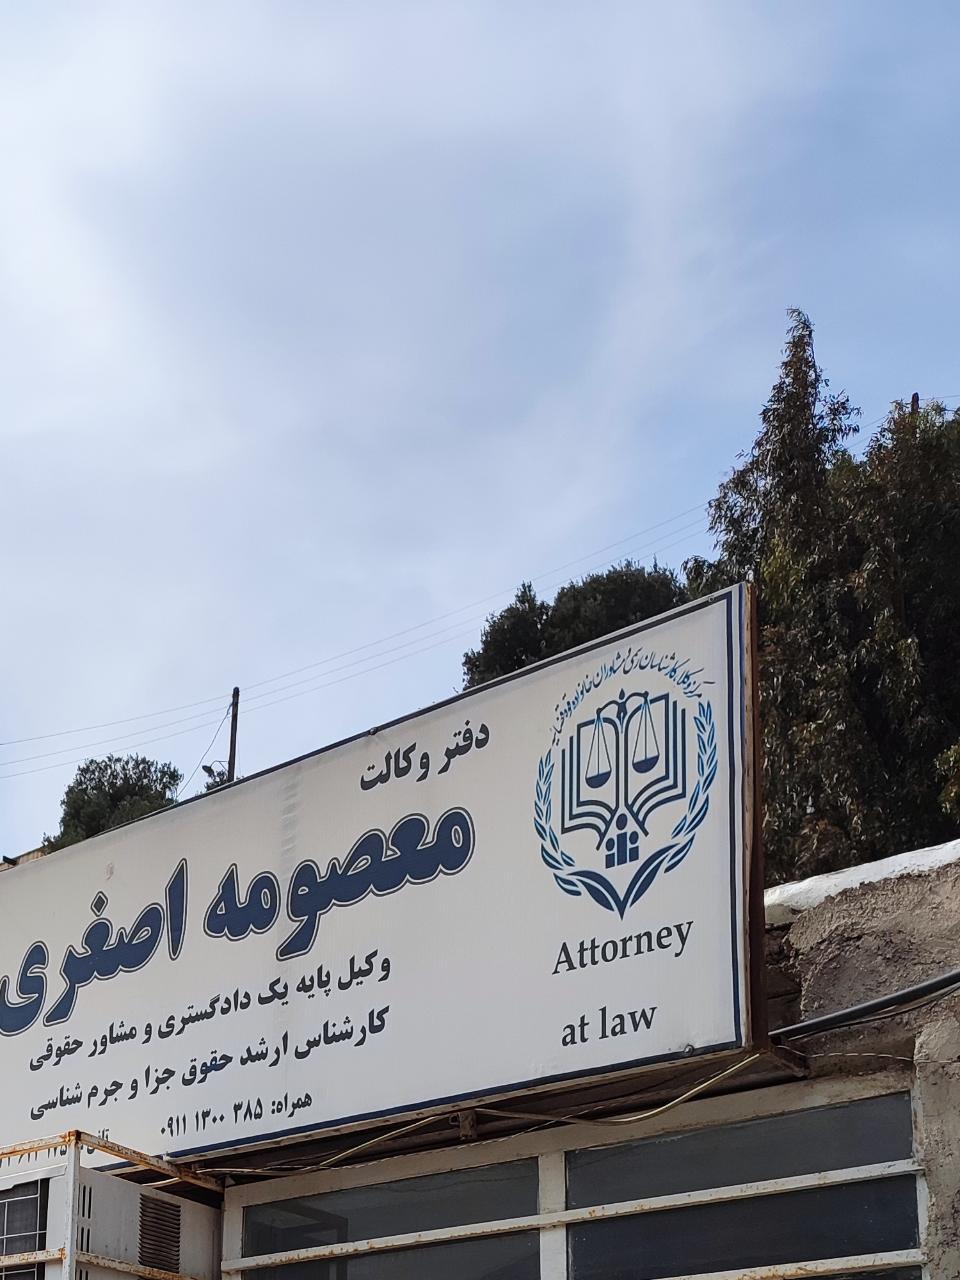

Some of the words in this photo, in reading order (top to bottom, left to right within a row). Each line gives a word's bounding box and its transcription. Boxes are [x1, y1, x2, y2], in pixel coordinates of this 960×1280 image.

[437, 719, 490, 775] دفتر
[360, 742, 431, 790] وکالت
[203, 806, 476, 961] معصومه
[552, 921, 694, 975] Attorney
[296, 964, 331, 999] پایه
[338, 950, 391, 991] وکیل
[257, 977, 288, 1006] یک
[157, 988, 250, 1039] دادگستری
[562, 1014, 589, 1047] at
[599, 1006, 657, 1040] law
[87, 1020, 137, 1058] مشاور
[141, 1021, 153, 1044] و
[239, 1031, 288, 1068] ارشد
[294, 1005, 390, 1060] کارشناس
[29, 1035, 83, 1072] حقوقی
[181, 1051, 233, 1087] حقوق
[87, 1079, 123, 1108] جرم
[129, 1076, 139, 1099] و
[144, 1066, 176, 1095] جزا
[30, 1082, 83, 1121] شناسی
[195, 1108, 225, 1132] ۱۳۰۰
[233, 1097, 263, 1124] ۳۸۵
[271, 1093, 312, 1118] همراه:
[161, 1113, 187, 1137] ۰۹۱۱
